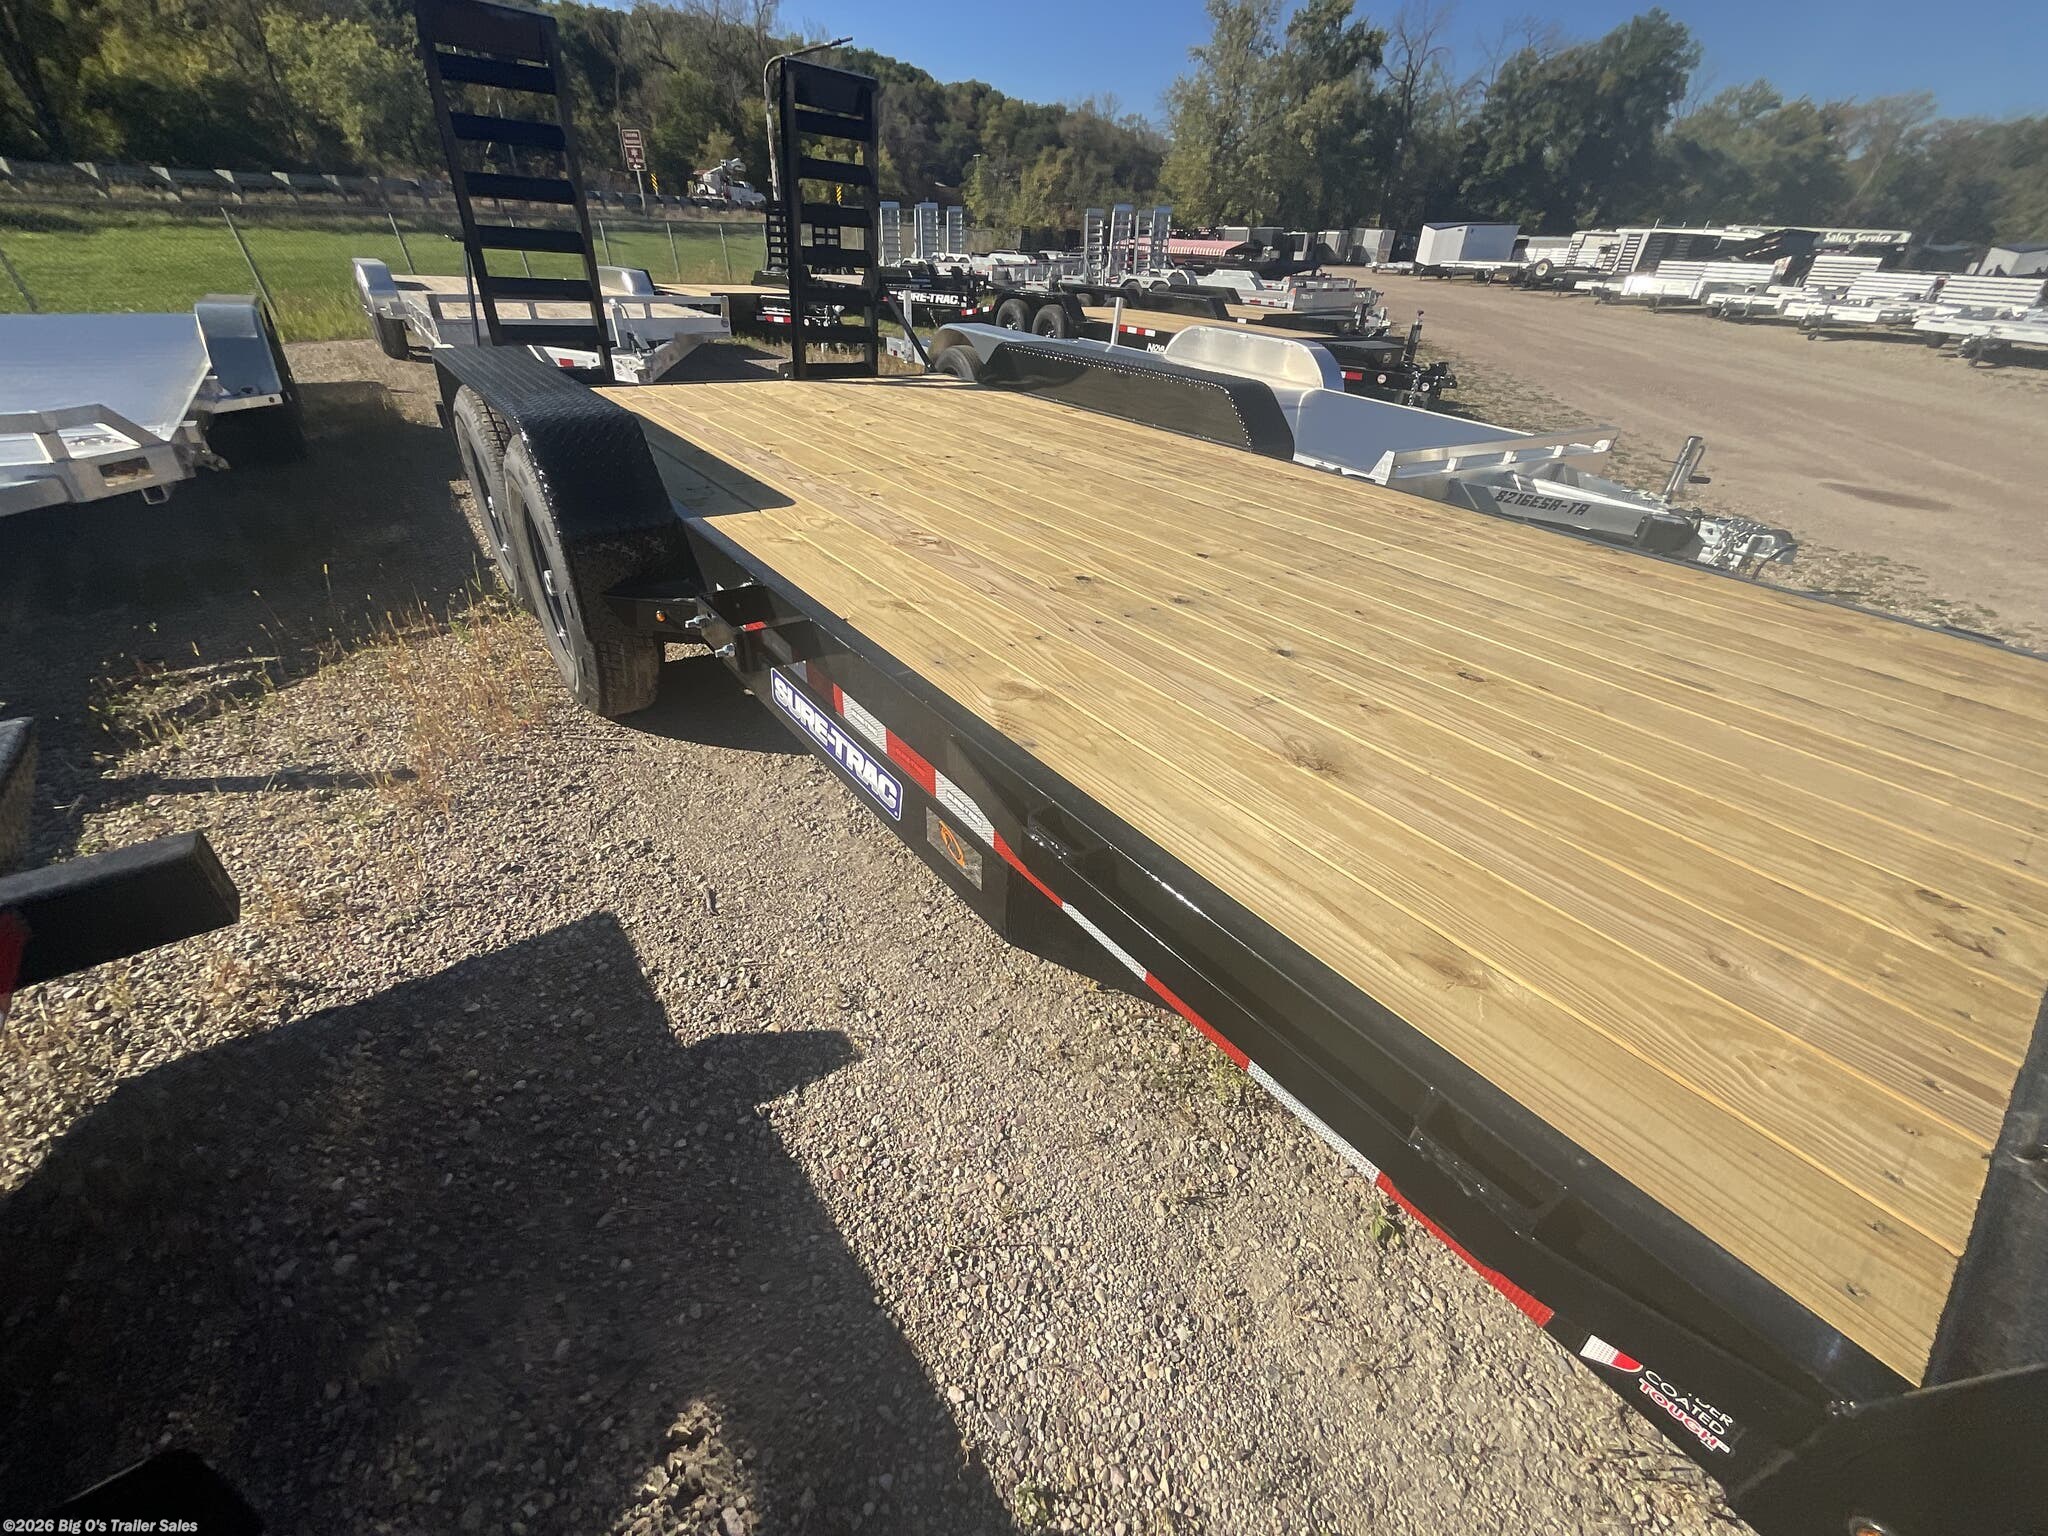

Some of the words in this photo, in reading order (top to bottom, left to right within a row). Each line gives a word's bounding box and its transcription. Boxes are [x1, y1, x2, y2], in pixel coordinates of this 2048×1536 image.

[1823, 231, 1851, 244] Sales,
[897, 290, 958, 305] SRE-TRAC
[774, 677, 898, 810] SURE-TRAC
[1638, 1377, 1719, 1450] TOUGH
[1645, 1370, 1725, 1435] COATED
